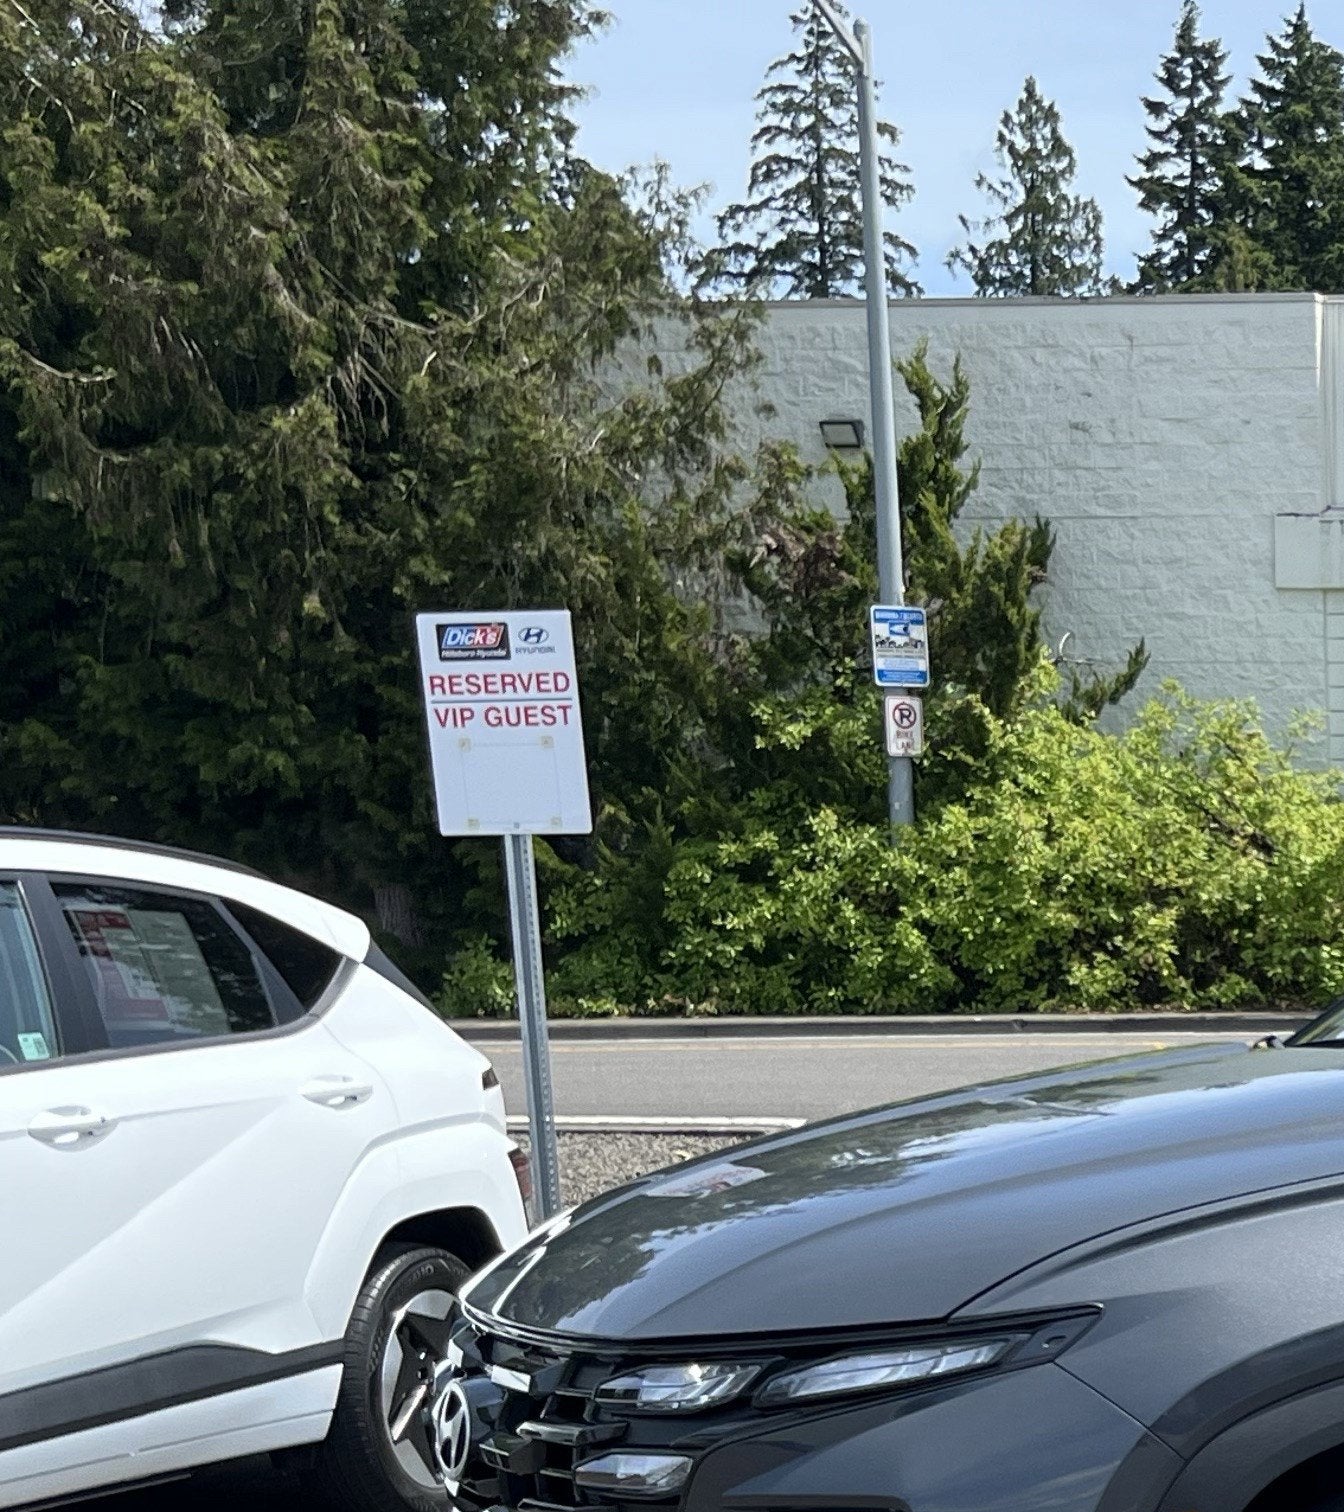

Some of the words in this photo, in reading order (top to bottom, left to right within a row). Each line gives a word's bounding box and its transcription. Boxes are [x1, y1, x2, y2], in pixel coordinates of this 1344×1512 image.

[429, 671, 570, 696] RESERVED
[434, 707, 475, 728] VIP
[484, 704, 573, 727] GUEST
